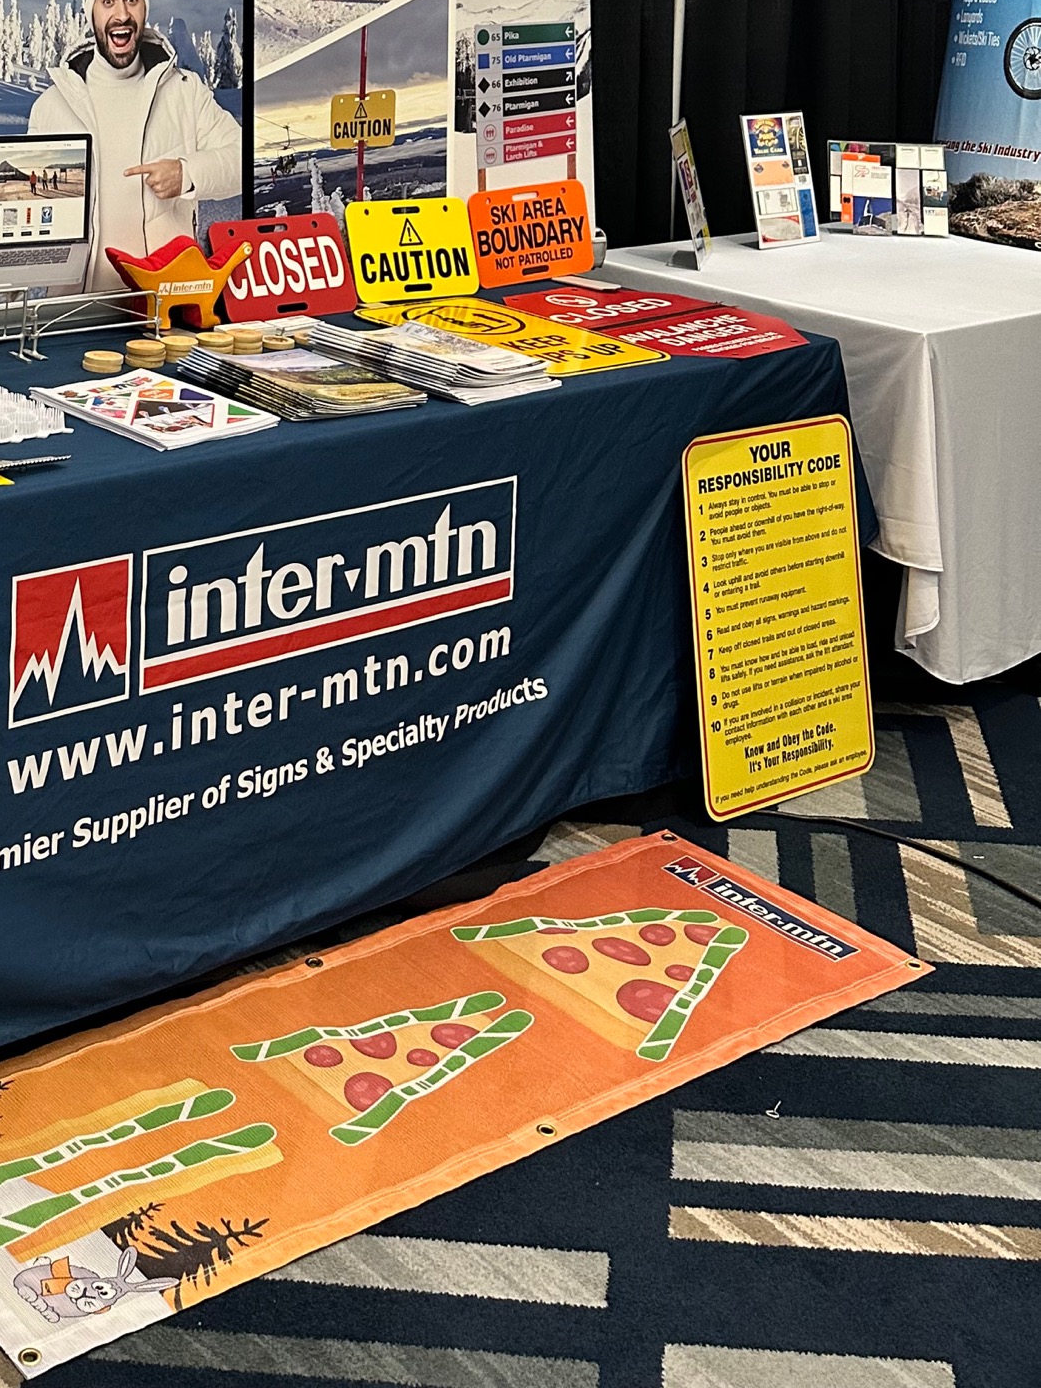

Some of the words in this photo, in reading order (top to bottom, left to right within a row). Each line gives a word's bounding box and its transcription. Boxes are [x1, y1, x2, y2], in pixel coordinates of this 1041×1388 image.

[491, 33, 500, 41] 65
[504, 32, 519, 40] Pika
[491, 56, 500, 64] 75
[505, 55, 516, 63] Old
[518, 53, 551, 62] Ptarmigan
[491, 81, 501, 89] 66
[505, 77, 538, 87] Exhibition
[492, 104, 501, 112] 76
[505, 100, 539, 111] Ptarmigan
[334, 118, 391, 139] CAUTION
[506, 124, 533, 134] Paradise
[506, 142, 537, 152] Ptarmigan
[506, 152, 522, 161] Larch
[524, 150, 537, 158] Lifts
[961, 141, 976, 151] the
[979, 142, 992, 154] Ski
[994, 144, 1041, 162] Industry
[490, 202, 517, 225] SKI
[522, 197, 566, 220] AREA
[478, 216, 584, 257] BOUNDARY
[227, 235, 346, 302] CLOSED
[361, 246, 471, 285] CAUTION
[495, 254, 515, 271] NOT
[518, 246, 573, 267] PATROLLED
[549, 298, 673, 324] CLOSED
[616, 314, 747, 344] AVALANCHE
[657, 324, 757, 347] DANGER
[499, 335, 567, 351] KEEP
[583, 343, 627, 360] UP
[749, 441, 791, 463] YOUR
[698, 461, 803, 494] RESPONSIBILITY
[809, 454, 841, 473] CODE
[7, 624, 511, 795] www.inter-mtn.com
[745, 743, 764, 759] Know
[767, 737, 780, 751] and
[783, 732, 800, 748] Obey
[802, 729, 814, 740] the
[816, 722, 836, 737] Code.
[72, 790, 195, 845] Supplier
[202, 774, 231, 809] of
[236, 758, 308, 799] Signs
[315, 748, 334, 773] &
[341, 712, 449, 768] Specialty
[453, 675, 549, 729] Products
[749, 758, 762, 773] It's
[764, 753, 779, 769] Your
[782, 739, 834, 762] Responsibility.
